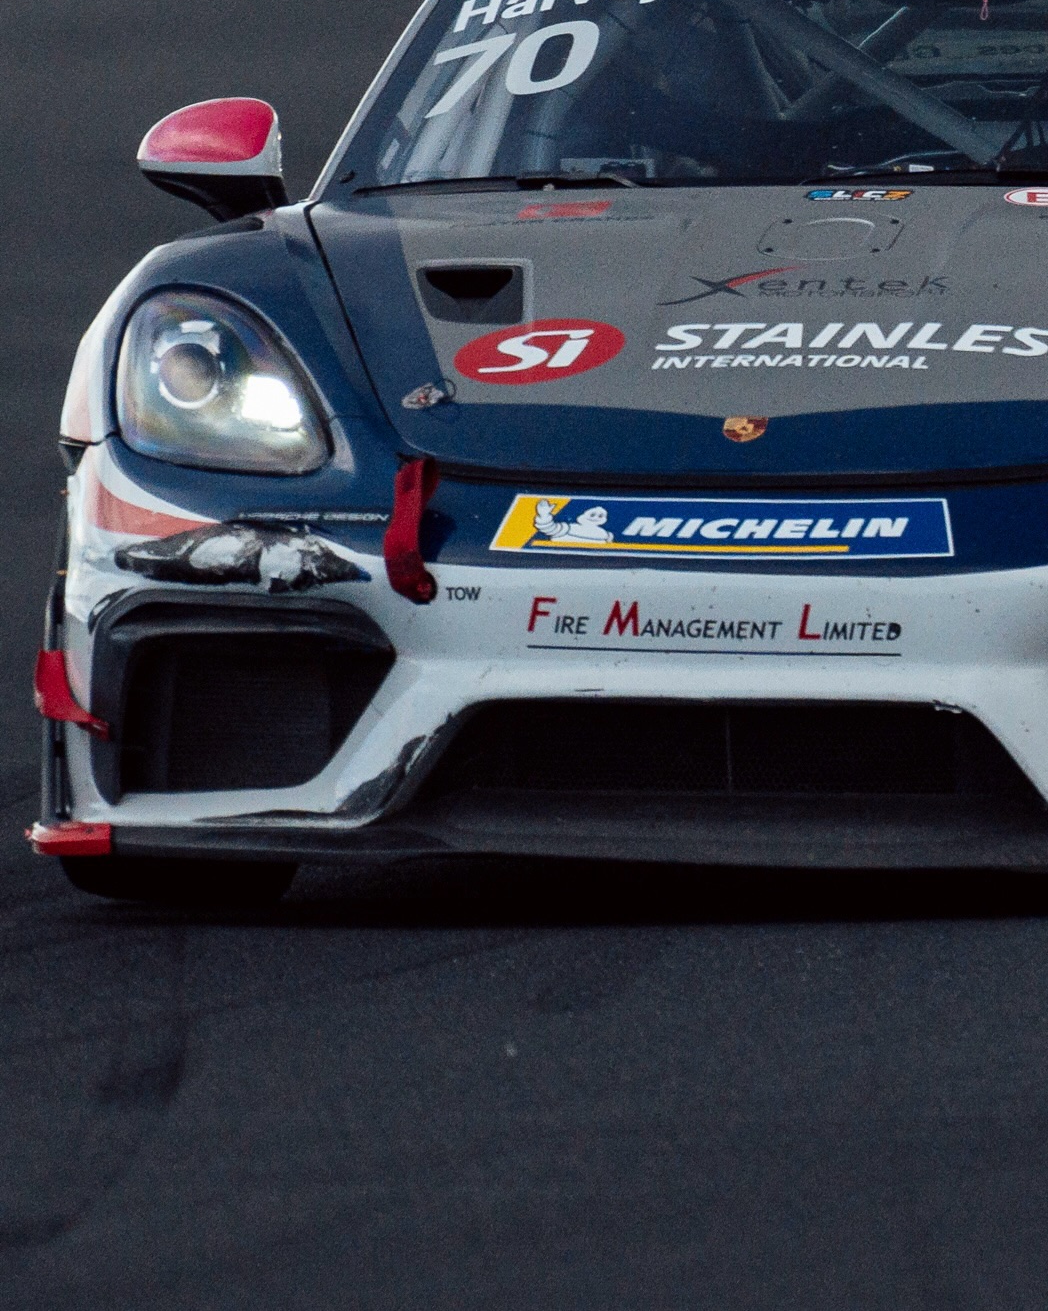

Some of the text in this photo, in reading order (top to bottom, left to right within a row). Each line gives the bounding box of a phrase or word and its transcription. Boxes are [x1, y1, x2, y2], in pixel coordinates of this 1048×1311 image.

[424, 20, 600, 119] 70
[651, 354, 929, 370] INTERNATIONAL
[622, 517, 909, 539] MICHELIN
[445, 586, 482, 601] TOW
